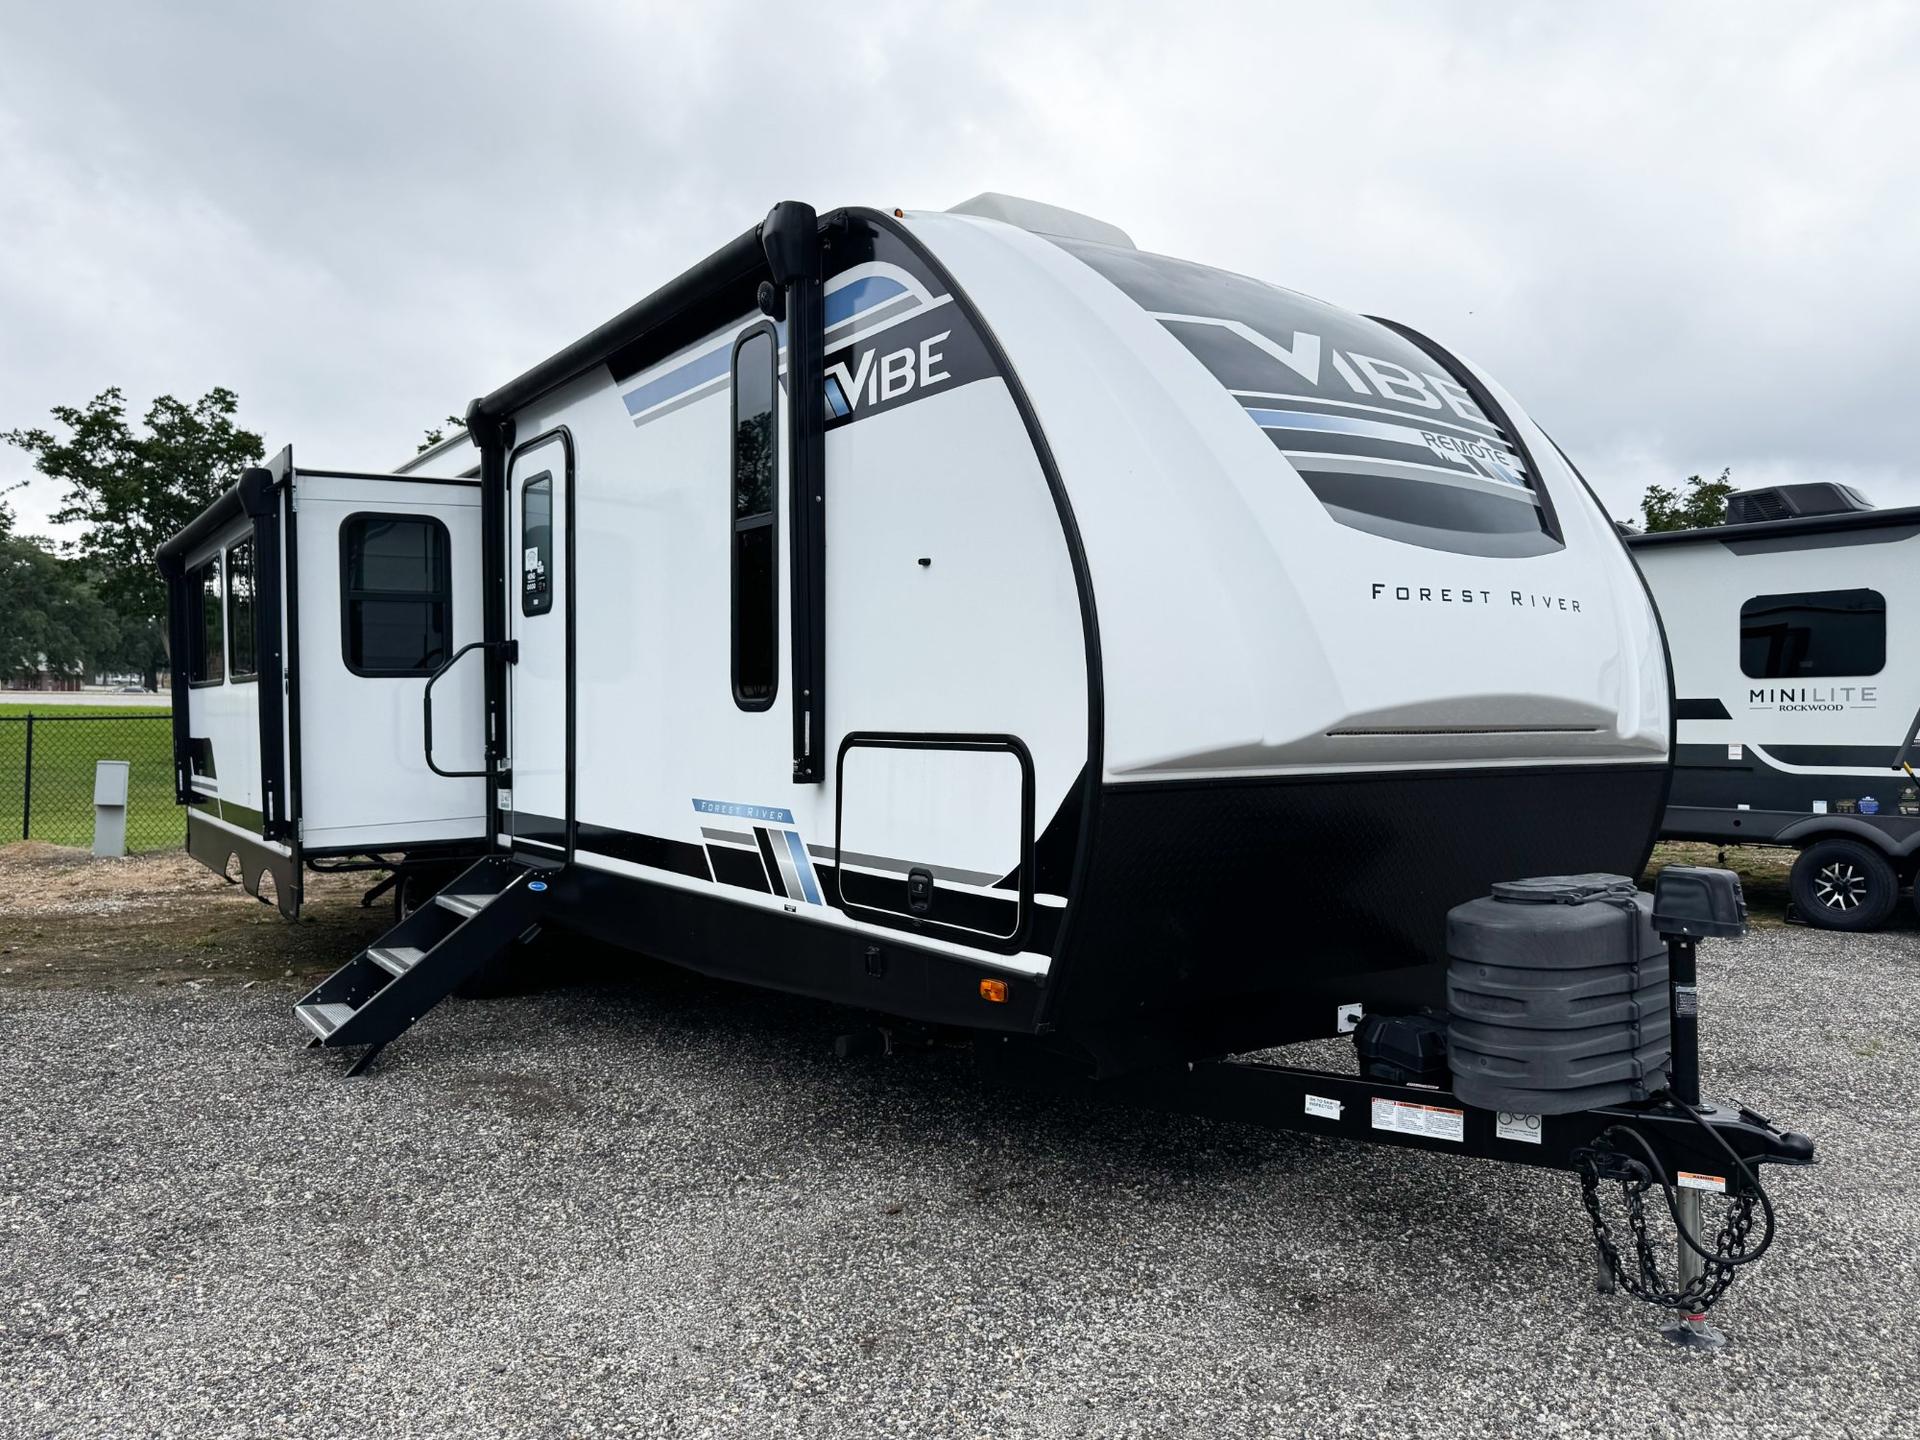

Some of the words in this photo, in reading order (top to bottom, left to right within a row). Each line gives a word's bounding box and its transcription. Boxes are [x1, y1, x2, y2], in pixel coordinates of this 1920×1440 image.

[824, 330, 951, 411] VIBE
[1180, 314, 1505, 432] VIBE
[1420, 431, 1510, 466] REMOTE
[1371, 583, 1490, 604] FOREST
[1510, 590, 1581, 613] RIVER
[1779, 704, 1844, 712] ROCKWOOD
[701, 801, 739, 816] FOREST
[747, 807, 784, 821] RIVER
